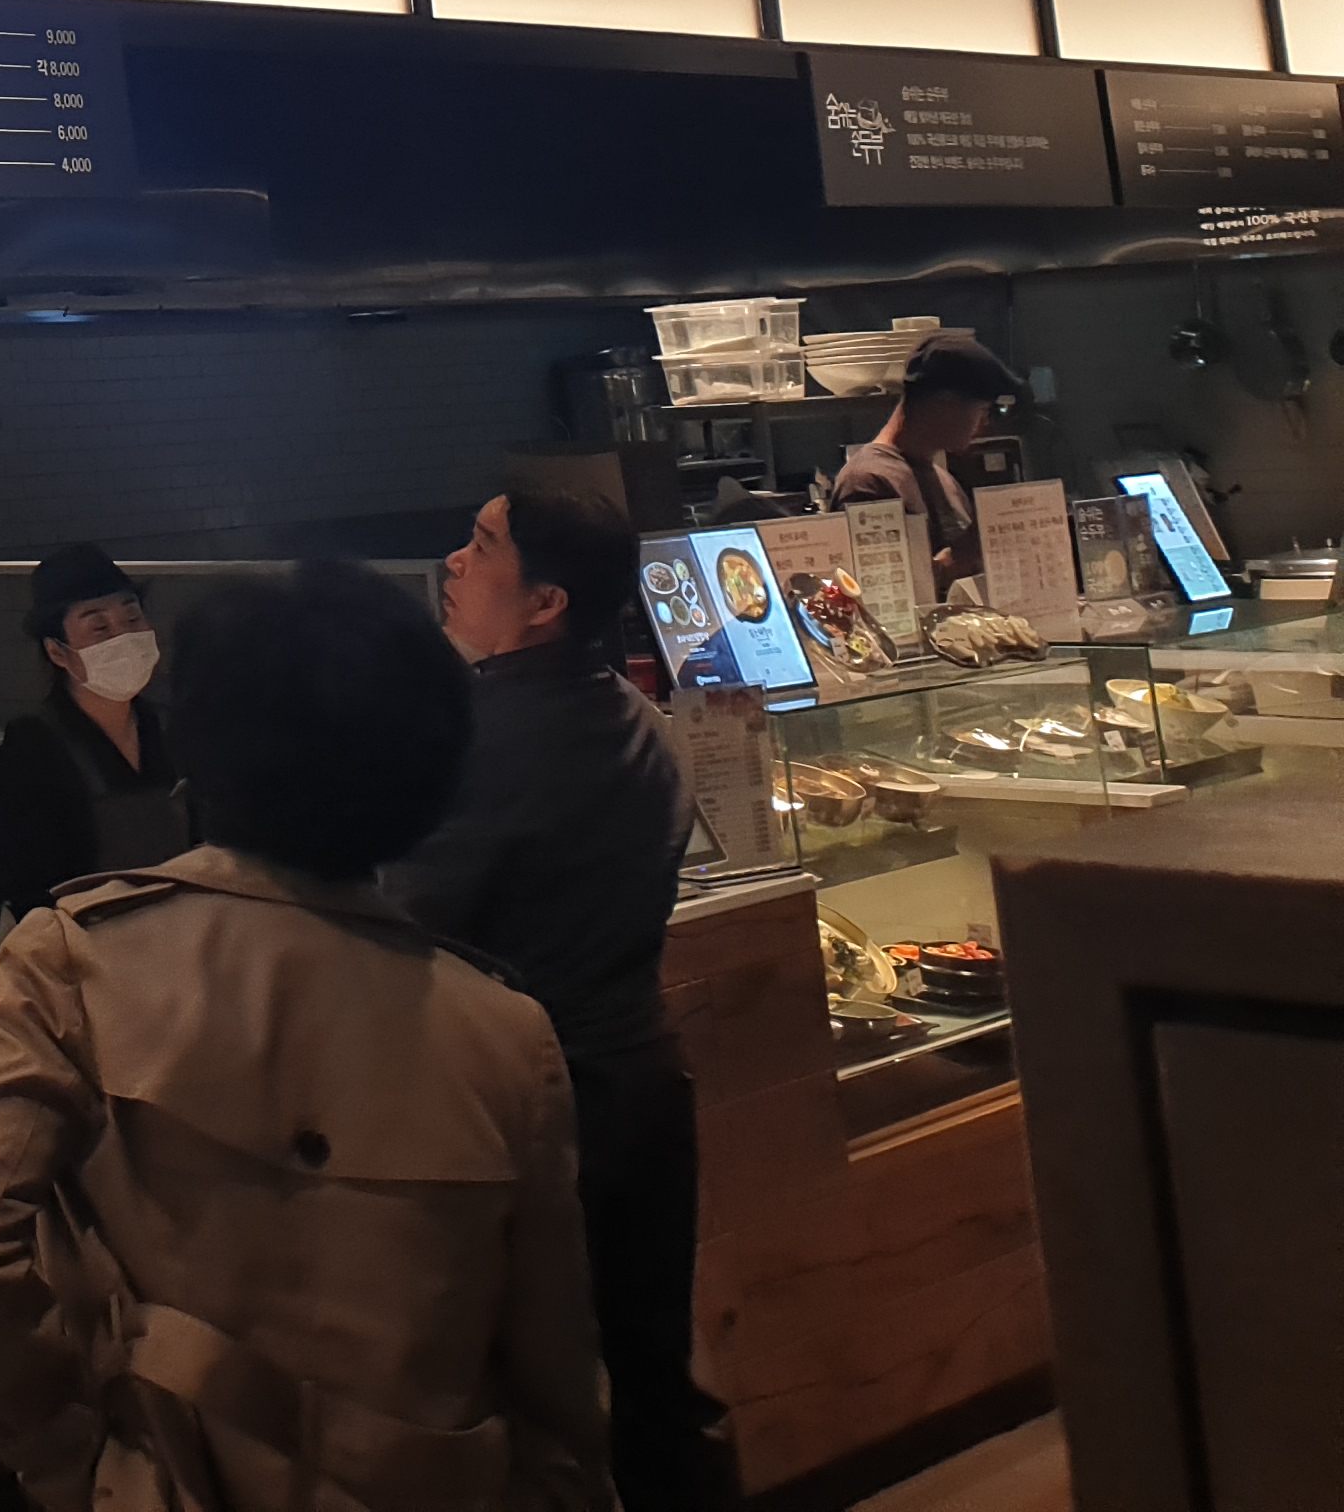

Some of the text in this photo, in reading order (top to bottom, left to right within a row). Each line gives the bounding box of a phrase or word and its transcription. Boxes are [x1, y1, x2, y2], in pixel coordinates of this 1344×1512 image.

[46, 30, 75, 44] 9,000
[37, 60, 48, 75] 각
[50, 61, 79, 76] 8,000
[54, 93, 83, 109] 8,000
[58, 125, 87, 141] 6,000
[62, 158, 91, 173] 4,000
[1247, 214, 1280, 226] 100%
